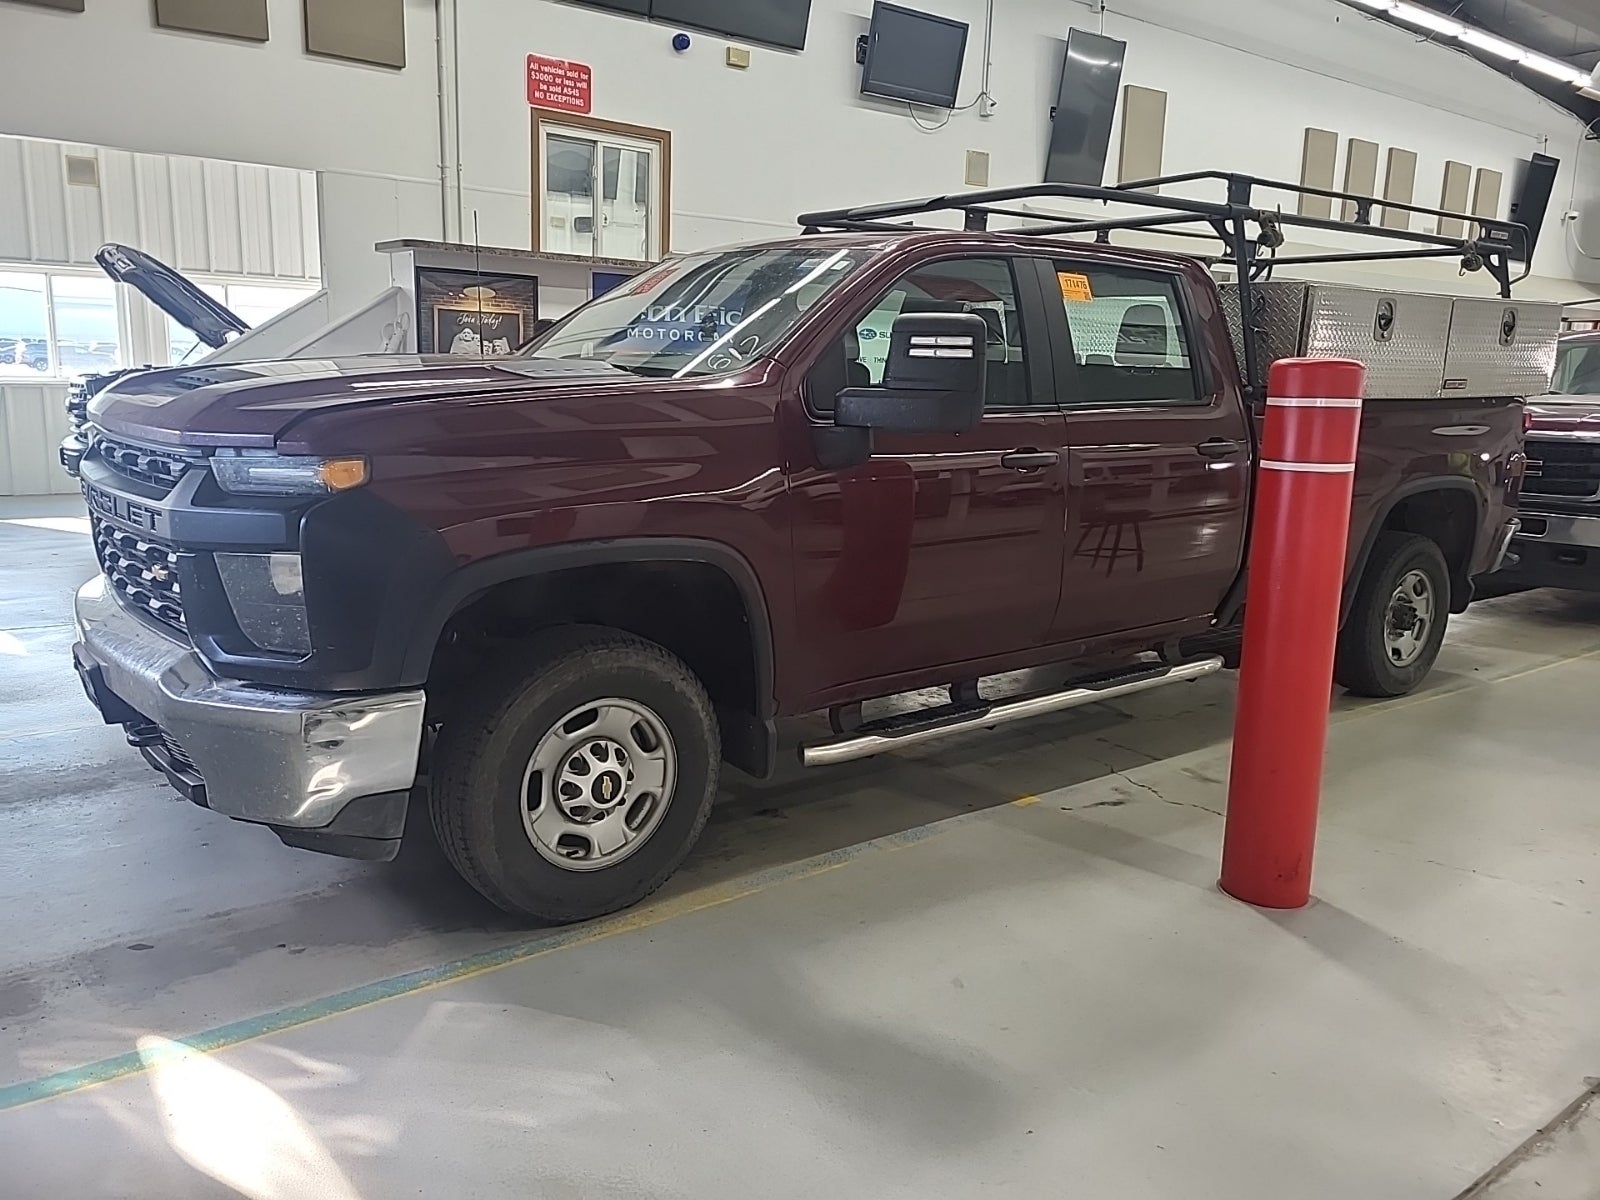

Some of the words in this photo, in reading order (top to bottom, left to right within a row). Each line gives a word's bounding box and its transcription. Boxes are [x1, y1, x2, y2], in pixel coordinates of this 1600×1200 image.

[530, 62, 539, 70] All
[541, 65, 565, 75] vehicles
[566, 70, 579, 79] sold
[580, 72, 589, 80] for
[531, 71, 553, 82] $3000
[563, 78, 575, 87] less
[575, 81, 588, 89] will
[540, 82, 547, 90] be
[549, 85, 562, 93] sold
[534, 90, 544, 98] NO
[546, 93, 584, 106] EXCEPTIONS
